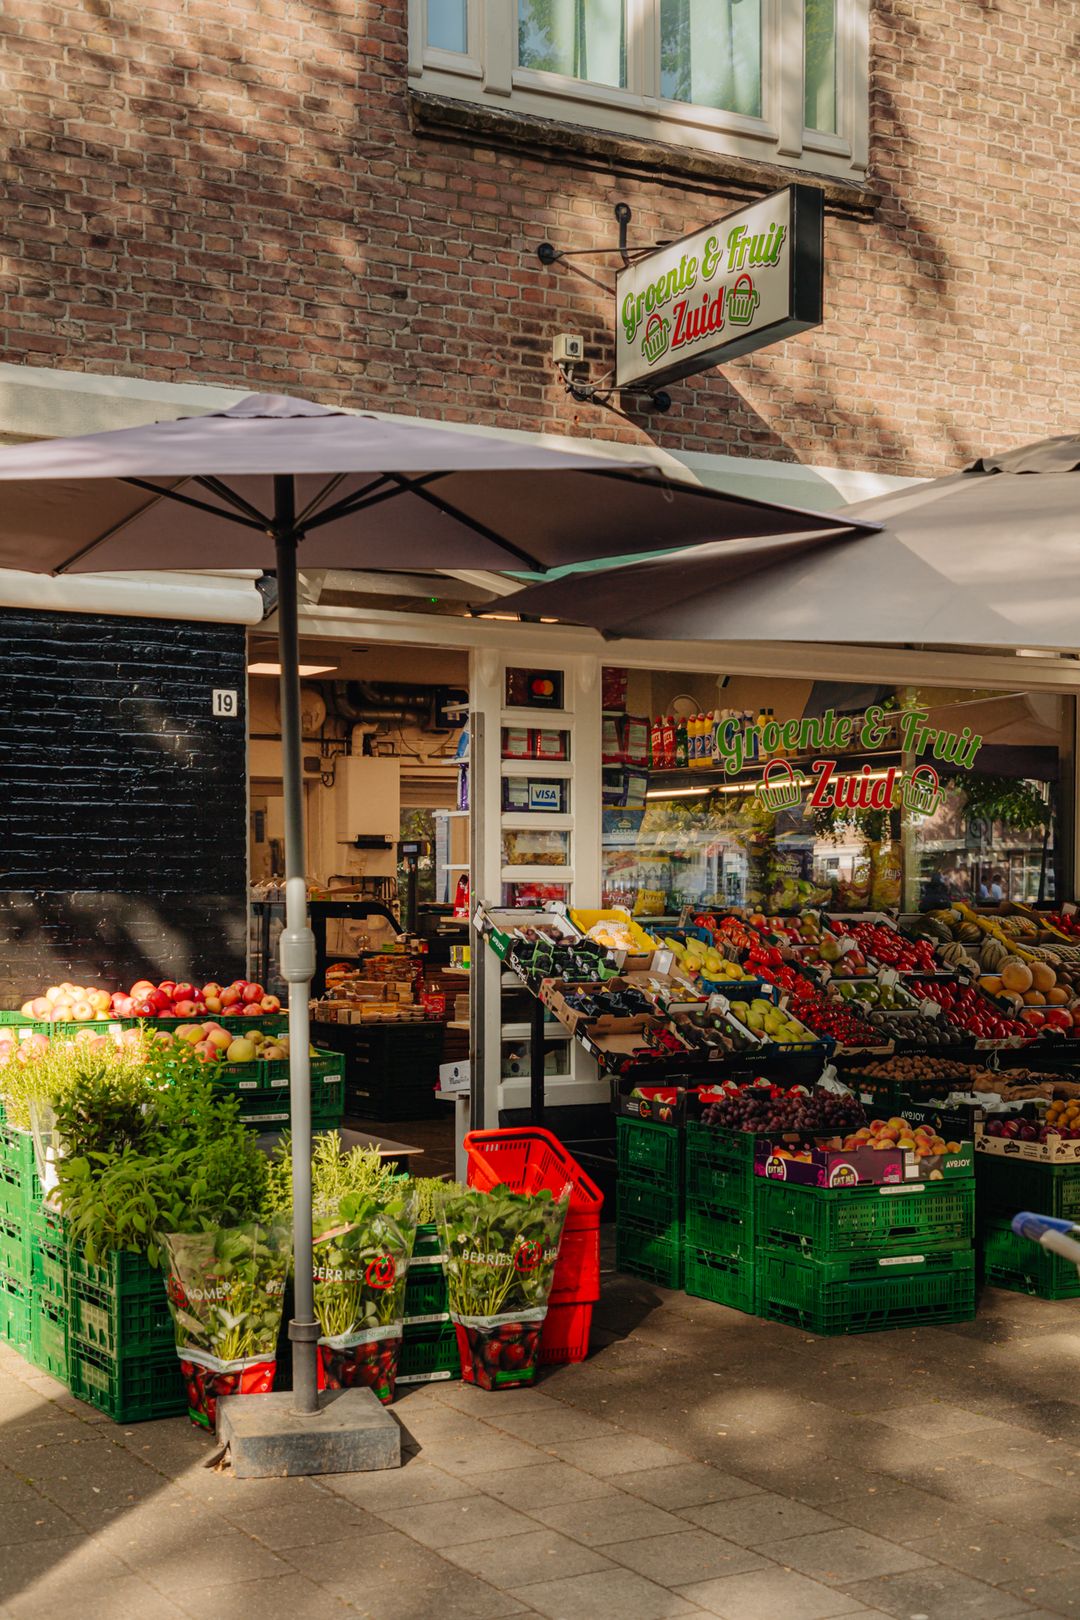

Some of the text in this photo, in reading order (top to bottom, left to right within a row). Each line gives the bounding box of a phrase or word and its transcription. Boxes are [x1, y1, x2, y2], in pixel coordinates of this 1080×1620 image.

[621, 222, 787, 343] Groente & Fruit
[671, 286, 726, 351] Zuid
[217, 693, 233, 712] 19
[716, 705, 982, 775] Groente & Fruit
[535, 789, 557, 800] VISA
[810, 759, 898, 809] Zuid
[462, 1249, 513, 1266] BERRIES
